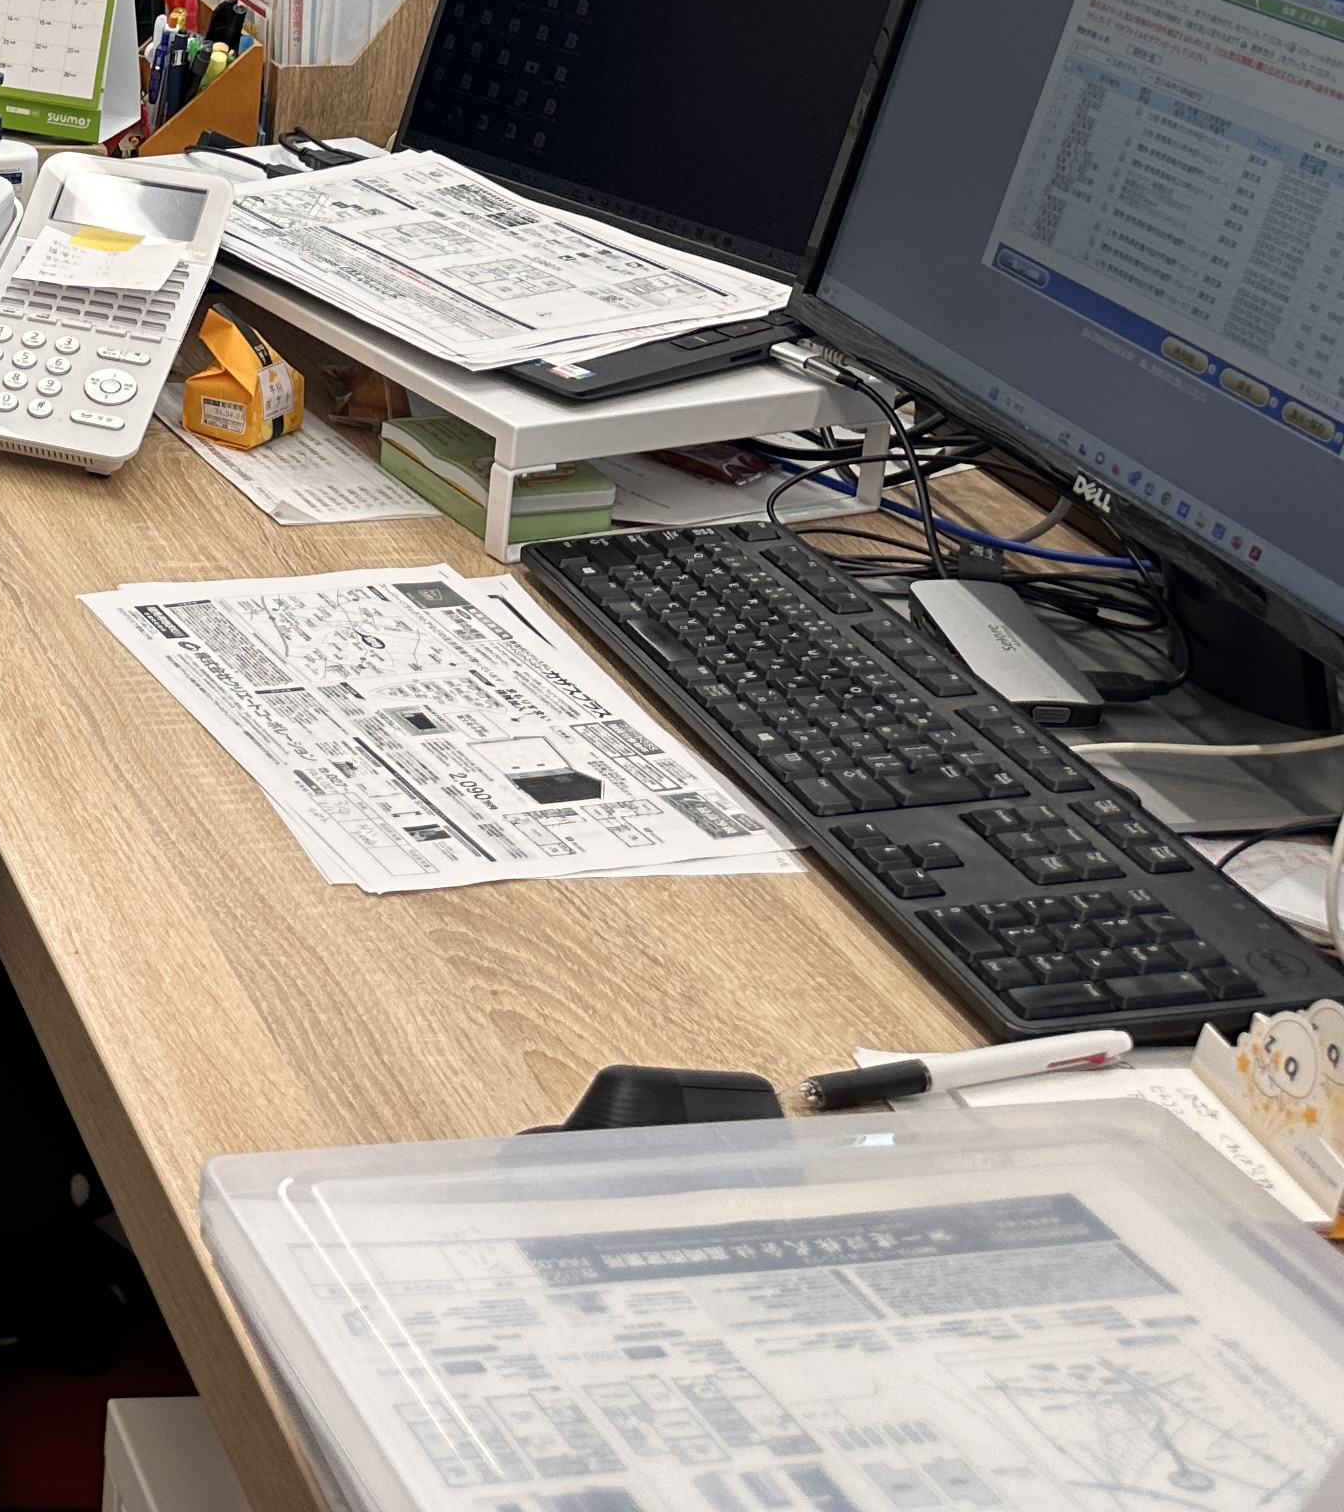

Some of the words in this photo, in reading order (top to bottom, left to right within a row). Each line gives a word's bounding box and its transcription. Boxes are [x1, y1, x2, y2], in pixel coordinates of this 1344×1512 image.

[1073, 475, 1111, 513] DELL
[194, 651, 318, 762] 株式会社クリエートコーポレーション
[542, 671, 613, 718] カザスプラス
